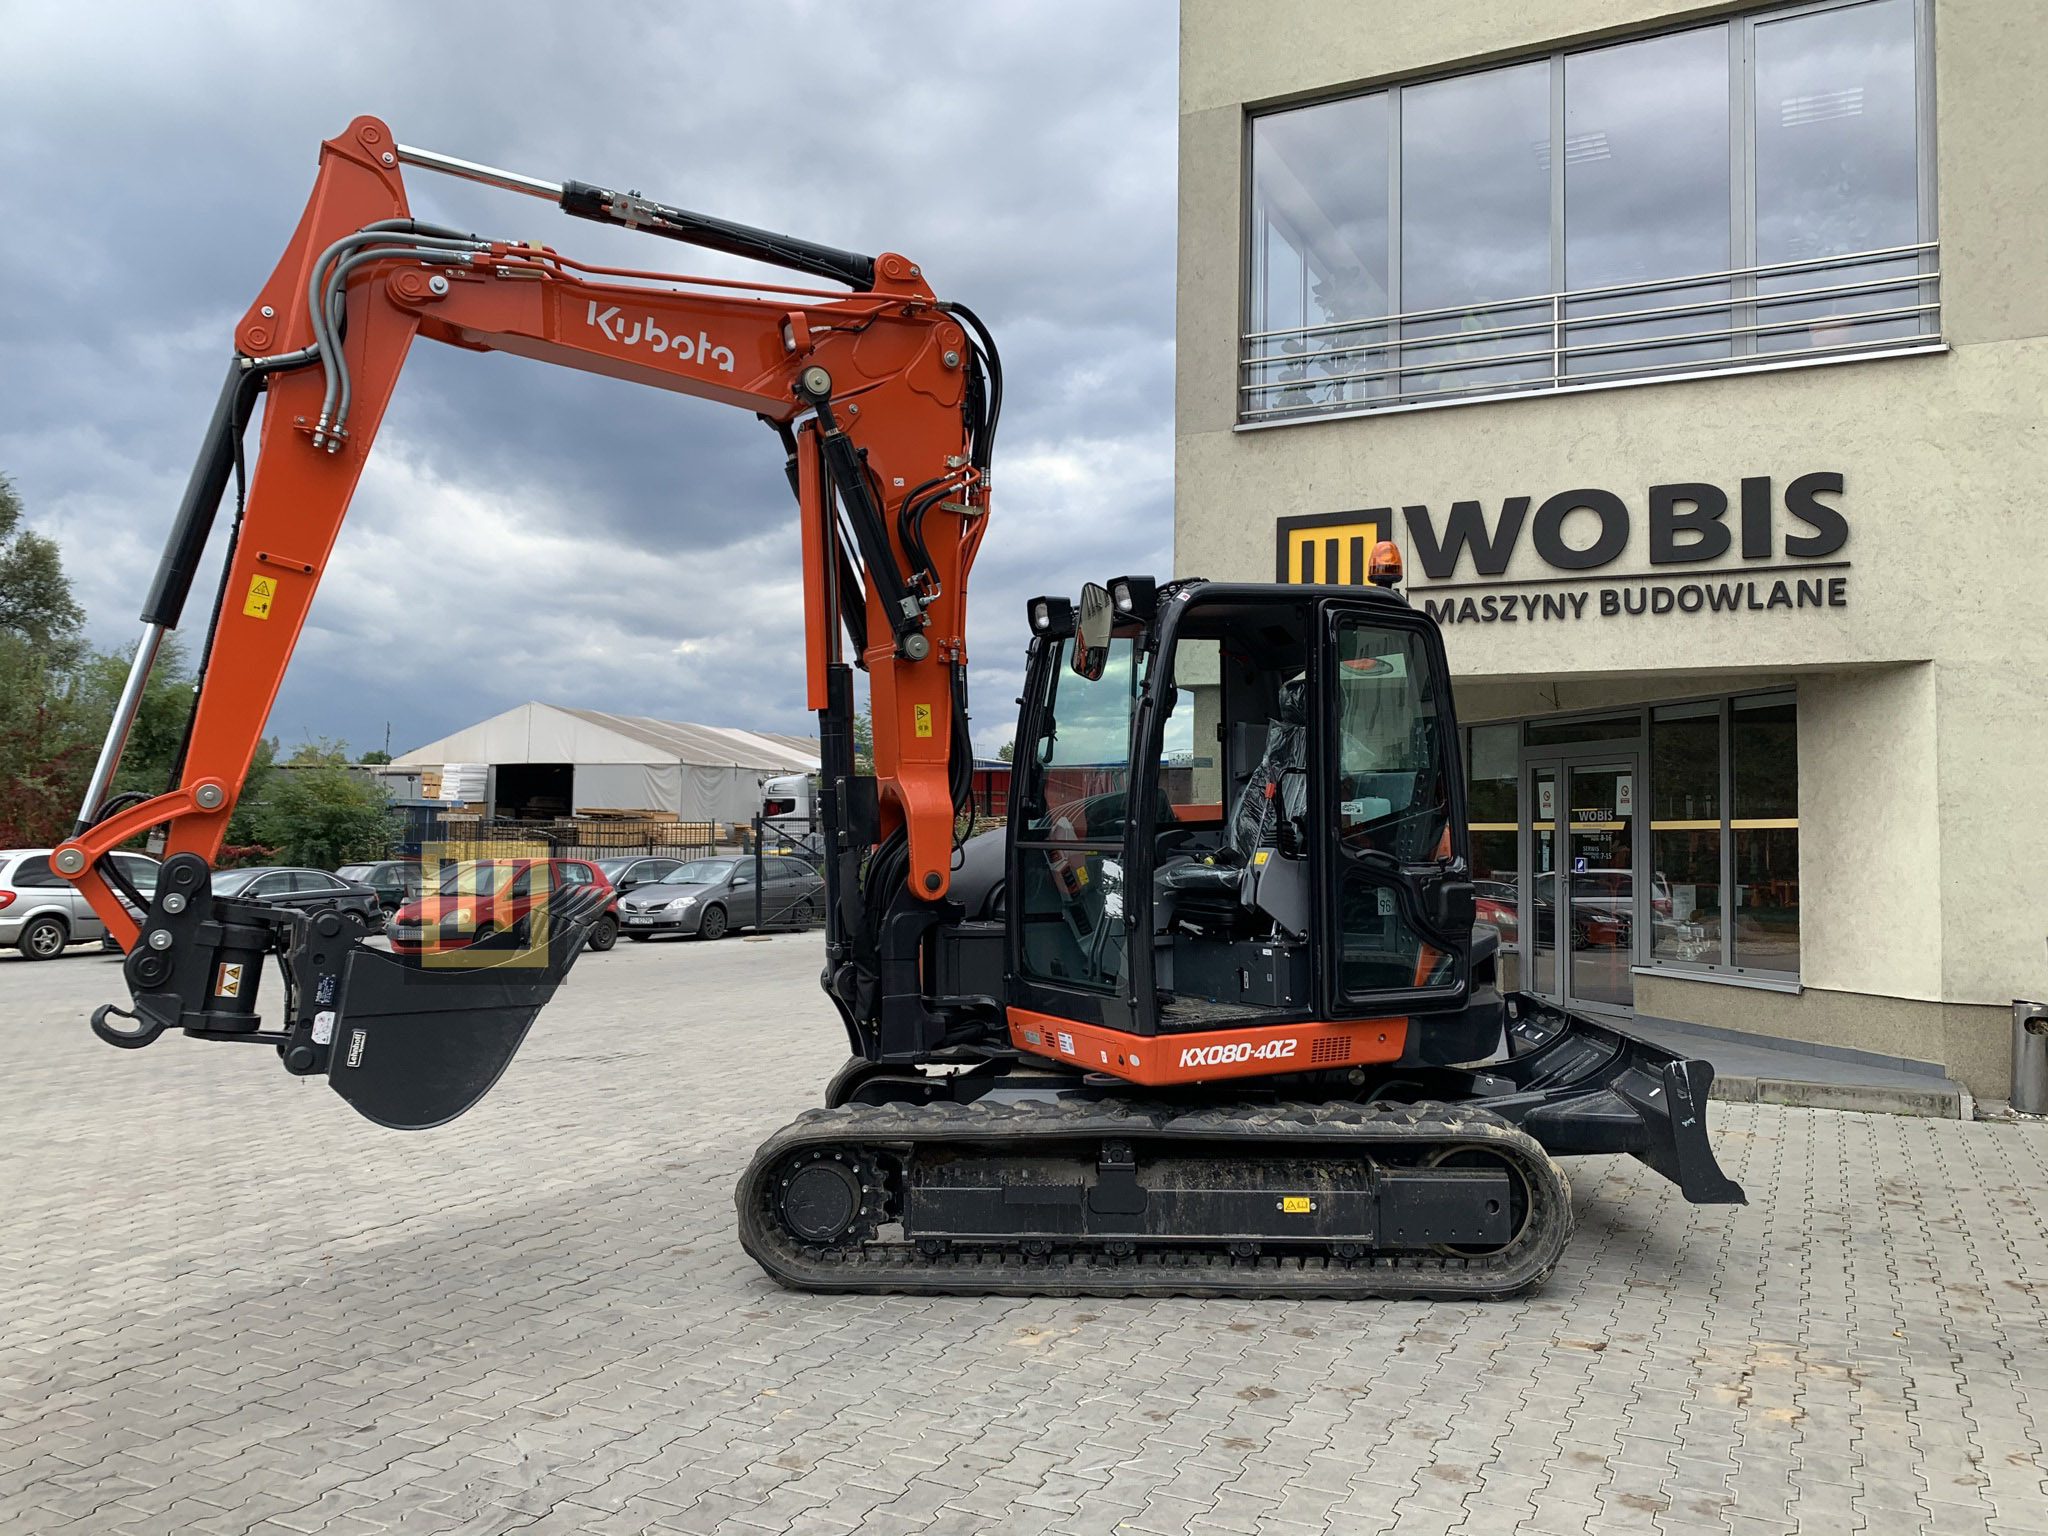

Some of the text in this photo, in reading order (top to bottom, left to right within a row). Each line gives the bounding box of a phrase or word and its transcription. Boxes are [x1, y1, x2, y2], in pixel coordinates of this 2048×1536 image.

[587, 300, 735, 372] Kubota
[1402, 472, 1849, 578] WOBIS
[1425, 578, 1847, 624] MASZYNY BUDOWLANE
[1578, 810, 1614, 822] WOBIS
[349, 1034, 362, 1065] Lehnhoff
